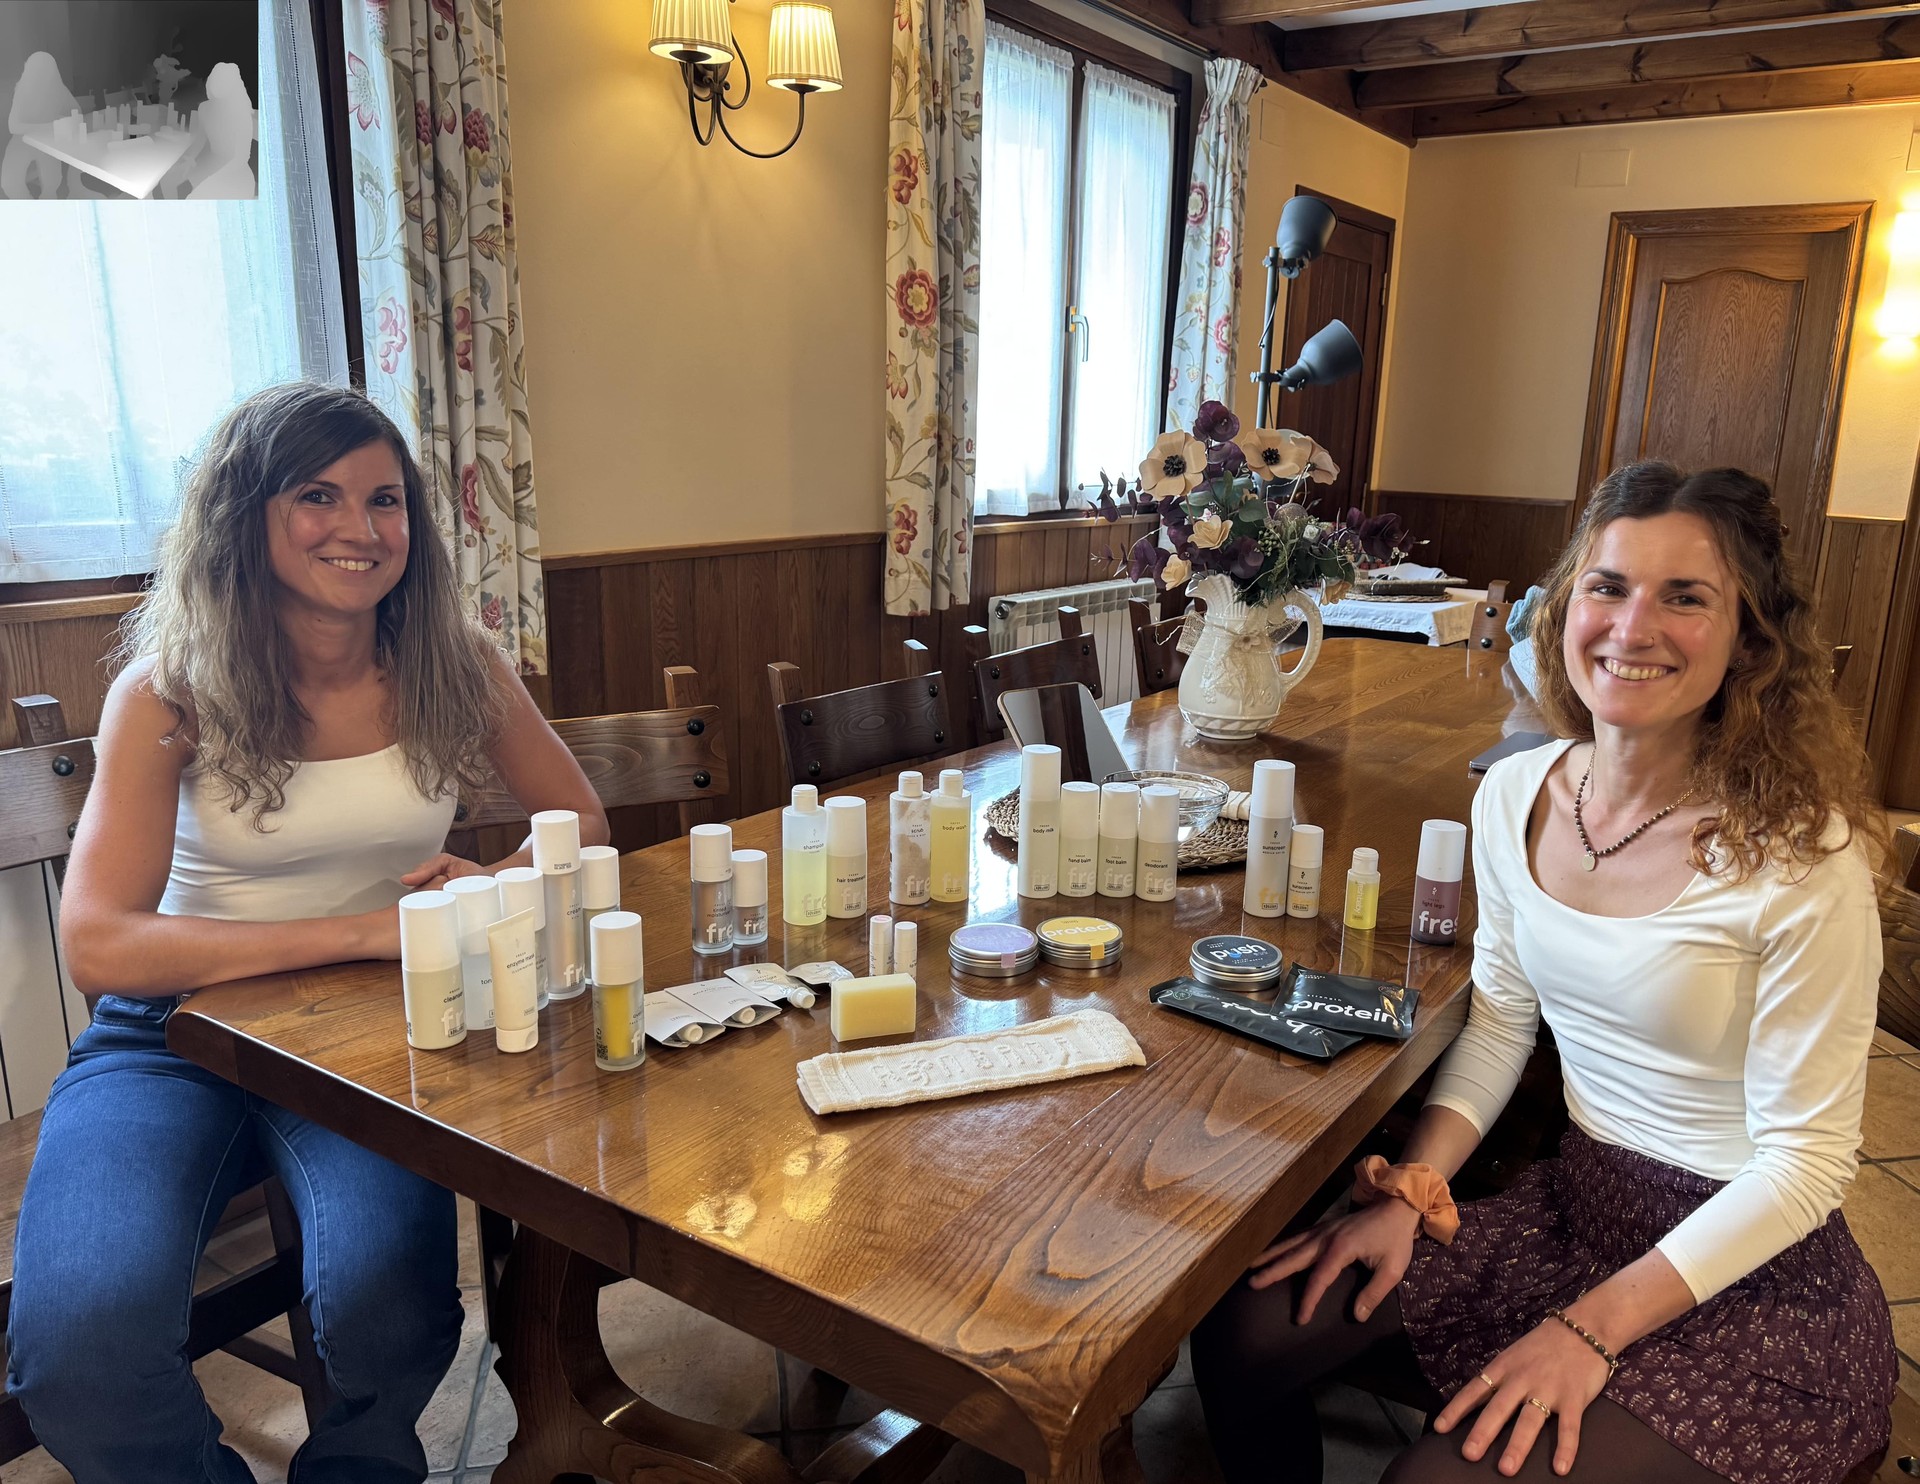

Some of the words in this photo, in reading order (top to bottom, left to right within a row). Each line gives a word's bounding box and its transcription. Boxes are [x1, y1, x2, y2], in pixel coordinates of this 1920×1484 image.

[803, 842, 825, 851] shampoo
[566, 907, 581, 916] cream
[1042, 922, 1115, 938] protect
[1209, 943, 1267, 961] push
[506, 958, 525, 970] enzyme
[1291, 1000, 1400, 1027] protein
